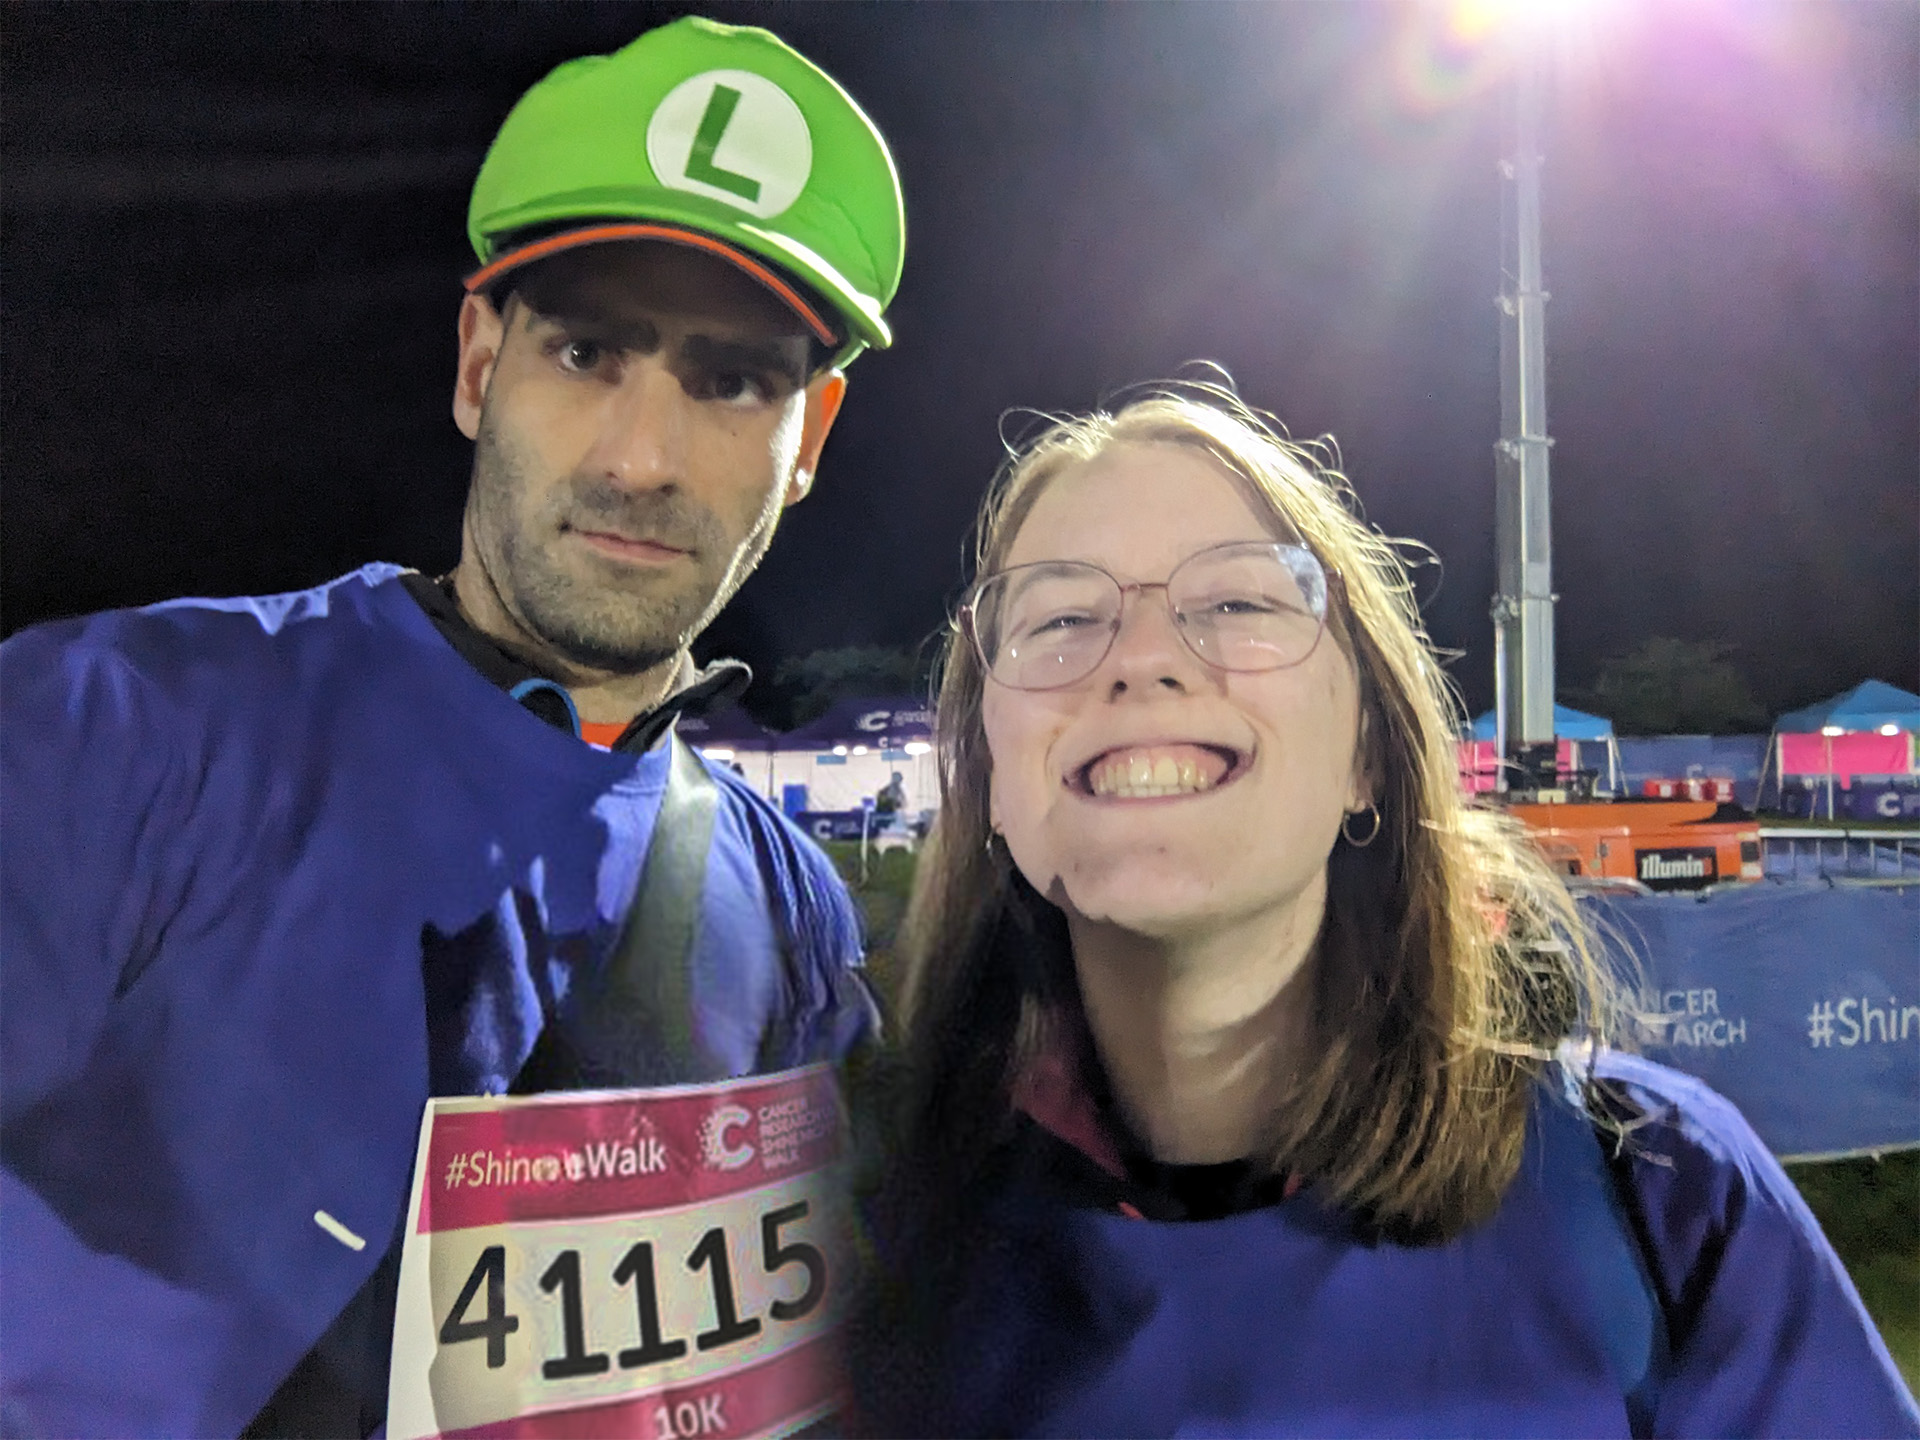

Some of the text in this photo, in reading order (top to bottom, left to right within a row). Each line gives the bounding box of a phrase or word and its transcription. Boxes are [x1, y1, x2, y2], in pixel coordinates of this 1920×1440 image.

[684, 83, 761, 204] L
[1808, 996, 1920, 1048] #Shin
[439, 1202, 827, 1381] 41115
[655, 1393, 727, 1439] 10K
